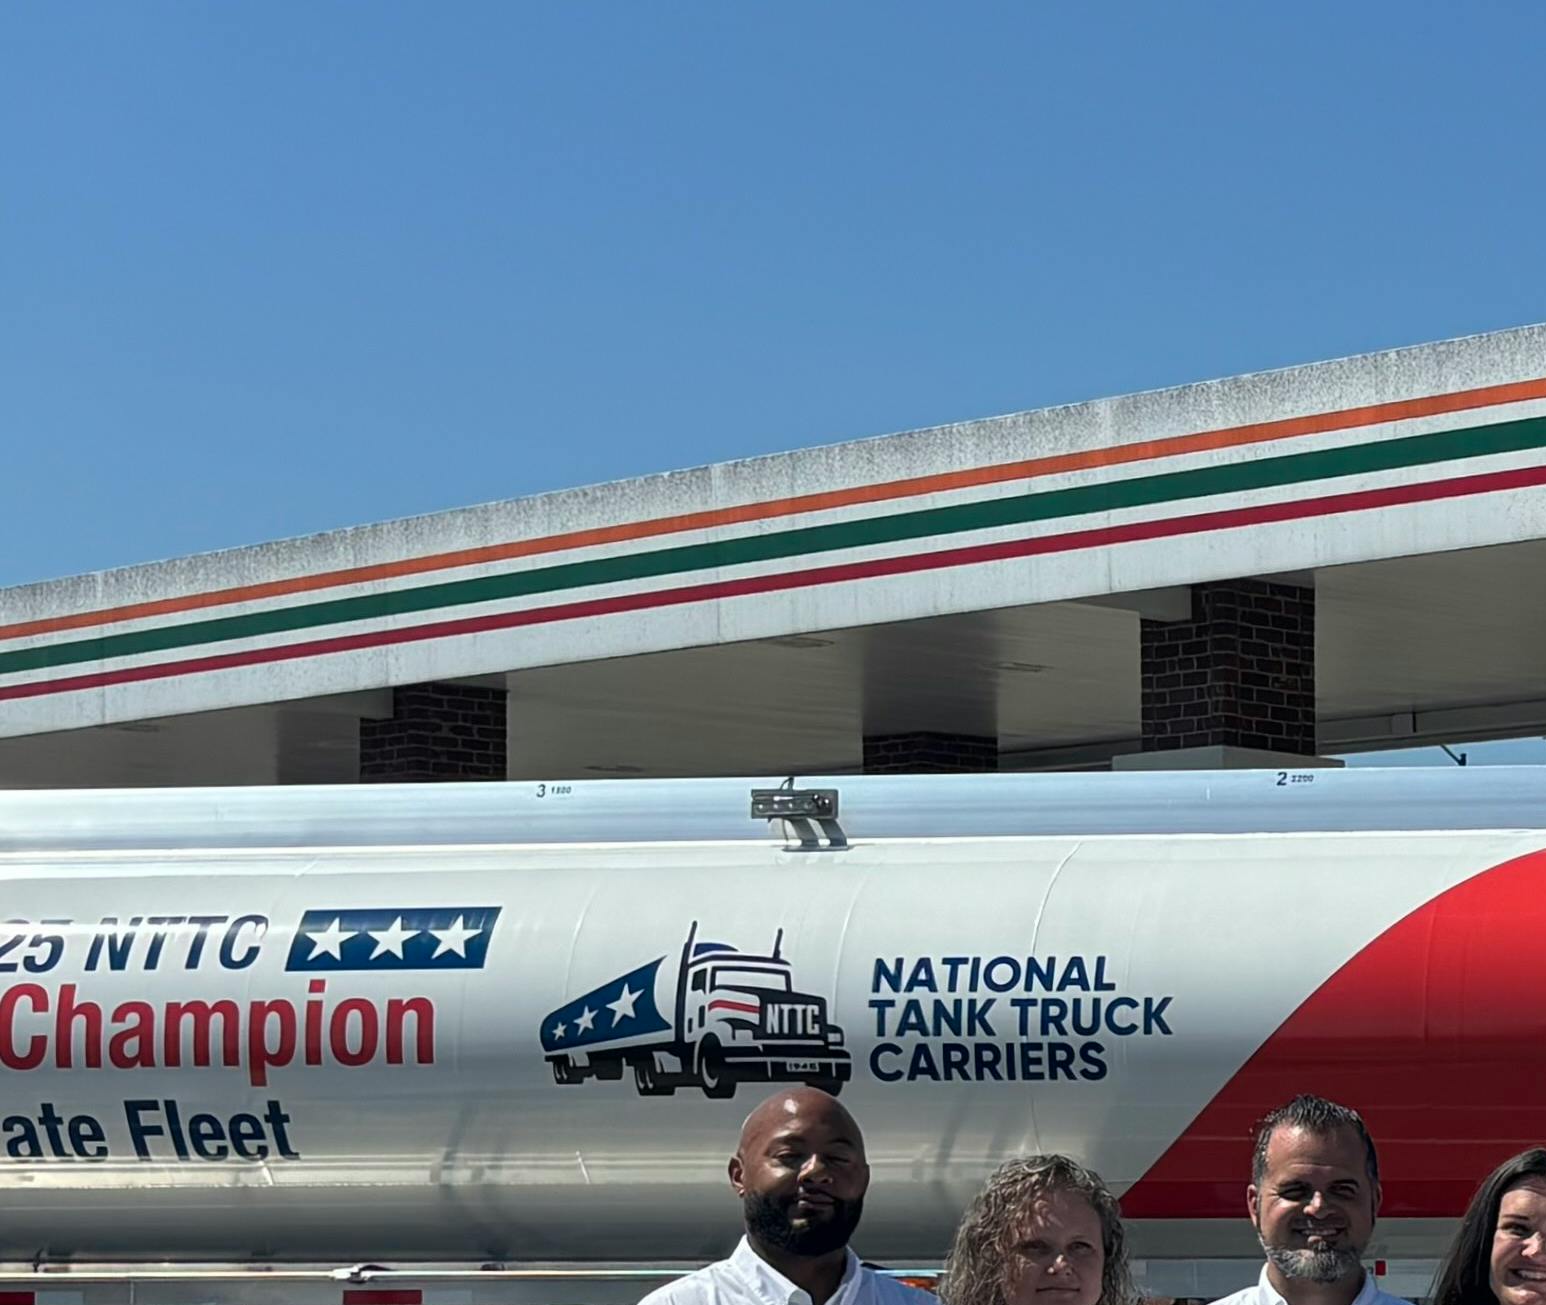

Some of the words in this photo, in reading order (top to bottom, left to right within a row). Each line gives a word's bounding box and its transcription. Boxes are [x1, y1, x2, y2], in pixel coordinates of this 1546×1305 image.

[536, 783, 546, 798] 3
[1276, 771, 1287, 786] 2
[83, 914, 269, 971] NTTC
[871, 955, 1116, 993] NATIONAL
[0, 978, 434, 1087] Champion
[766, 1003, 820, 1035] NTTC
[868, 998, 997, 1037] TANK
[1010, 996, 1173, 1037] TRUCK
[869, 1041, 1108, 1081] CARRIERS
[2, 1103, 108, 1162] ate
[124, 1099, 300, 1162] Fleet
